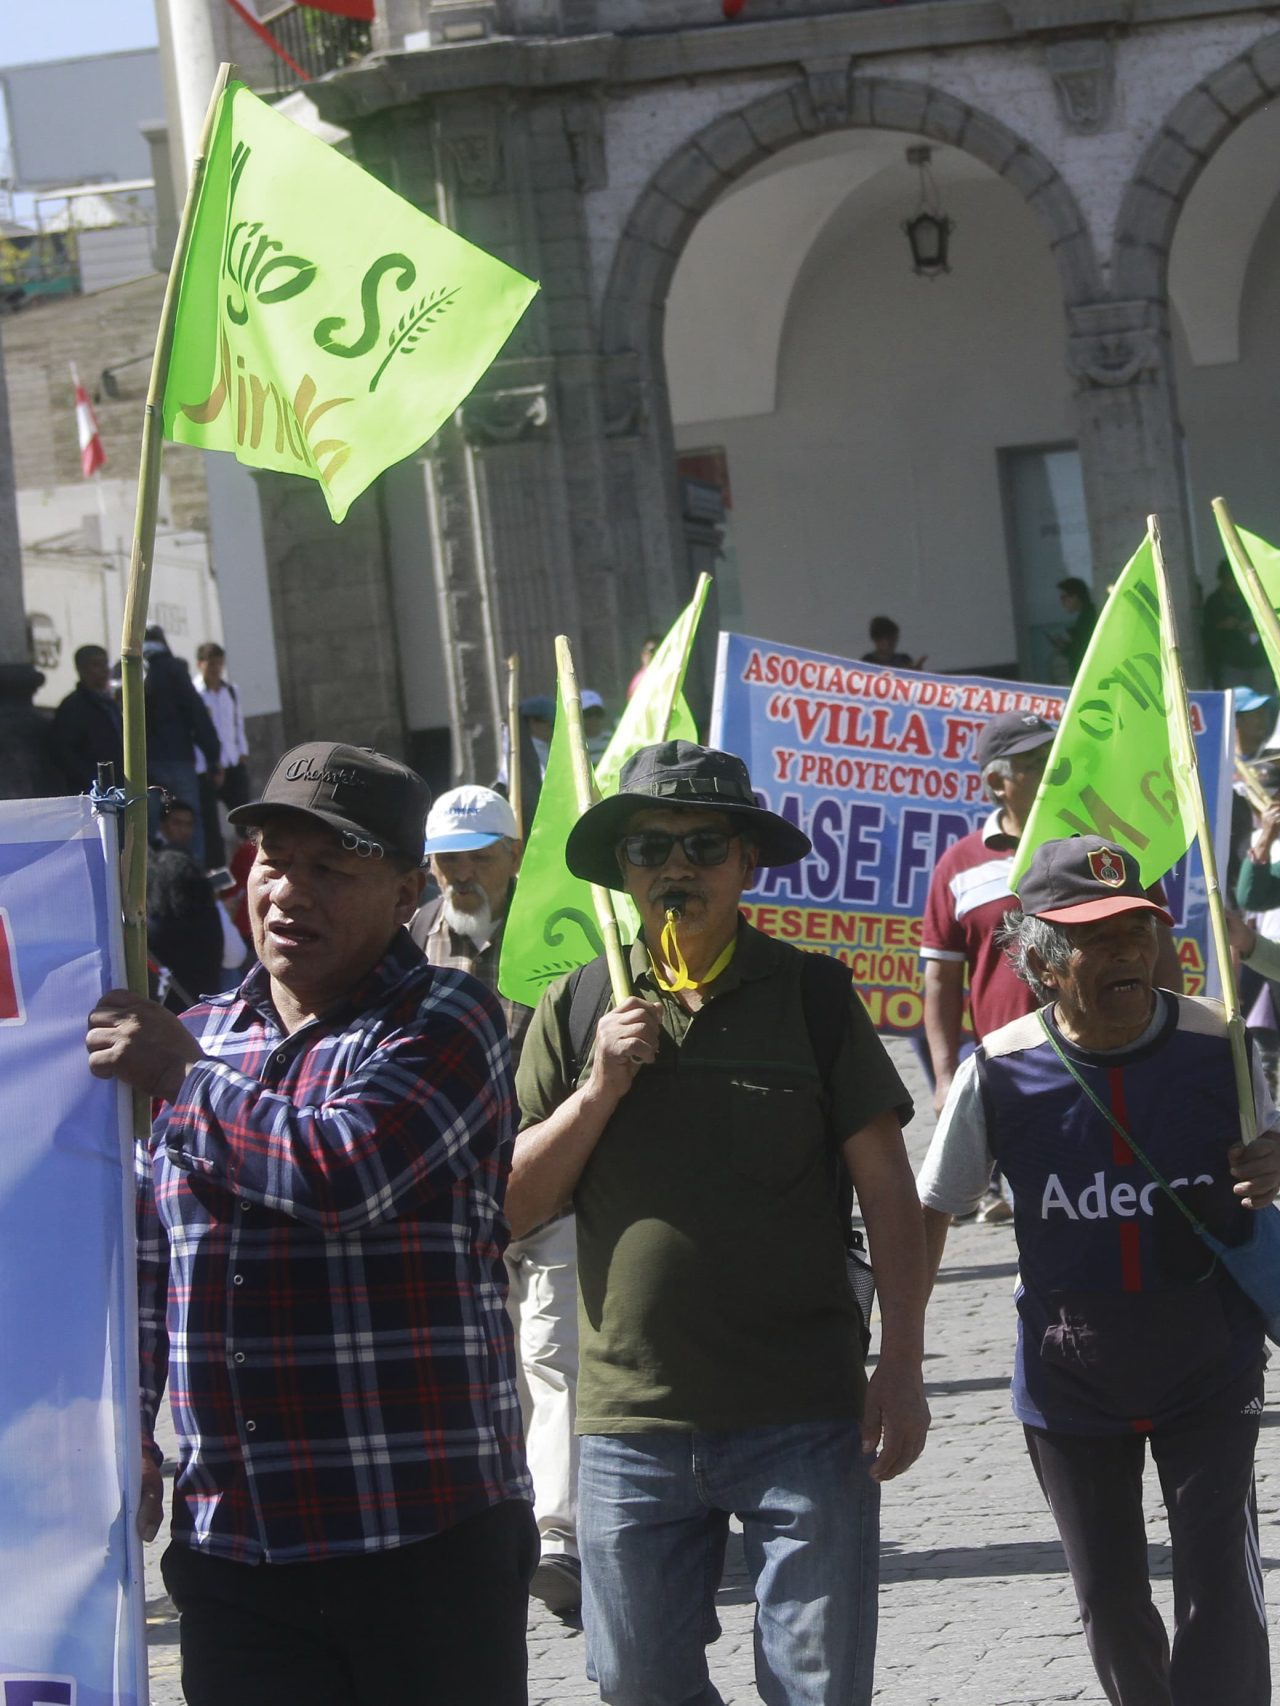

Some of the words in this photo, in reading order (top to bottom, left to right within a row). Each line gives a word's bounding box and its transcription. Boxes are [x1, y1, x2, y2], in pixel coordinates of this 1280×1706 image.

[744, 652, 911, 701] ASOCIACIÓN
[919, 682, 955, 708] DE
[962, 686, 1062, 720] TALLER
[775, 750, 795, 780] Y
[800, 754, 958, 800] PROYECTOS
[742, 788, 884, 903] ASE
